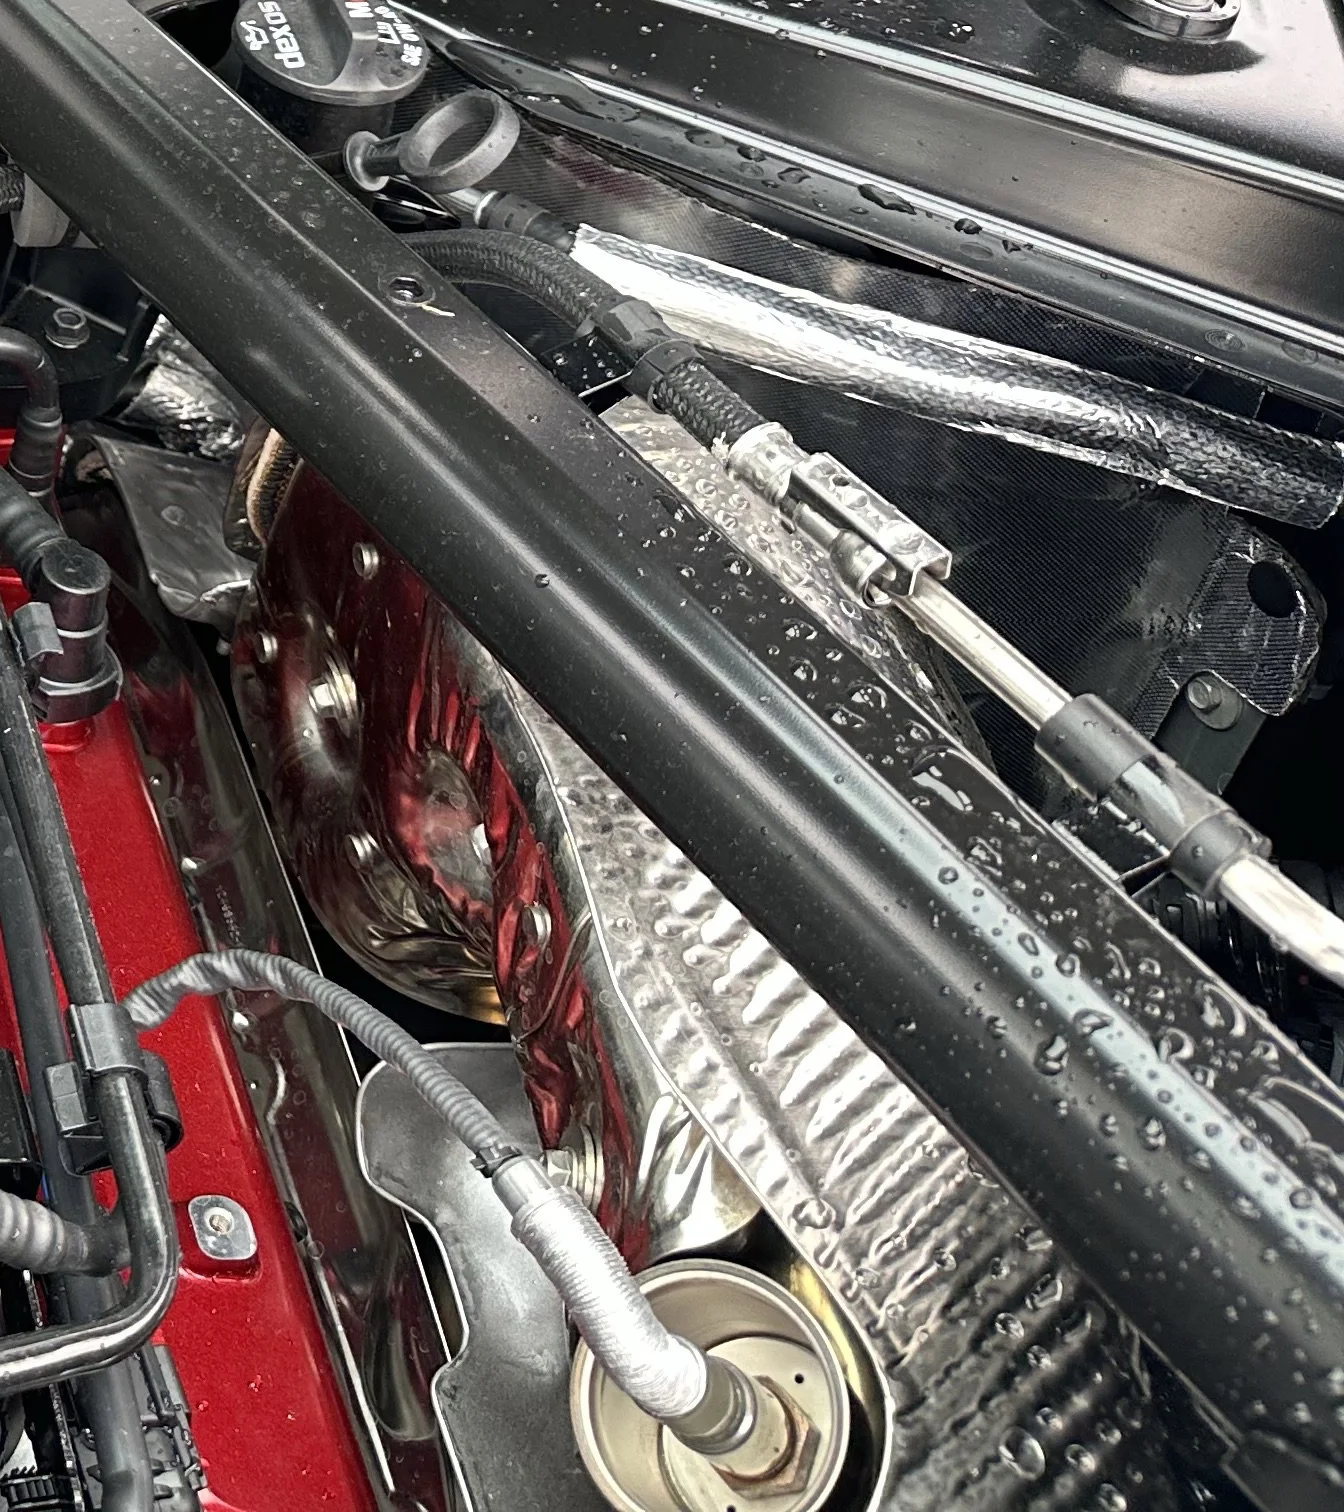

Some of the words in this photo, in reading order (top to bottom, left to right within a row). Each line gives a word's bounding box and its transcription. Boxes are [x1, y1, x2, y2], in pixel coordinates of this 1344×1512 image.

[257, 0, 306, 69] dexos
[374, 5, 420, 42] 0W-40
[400, 43, 423, 66] SAE
